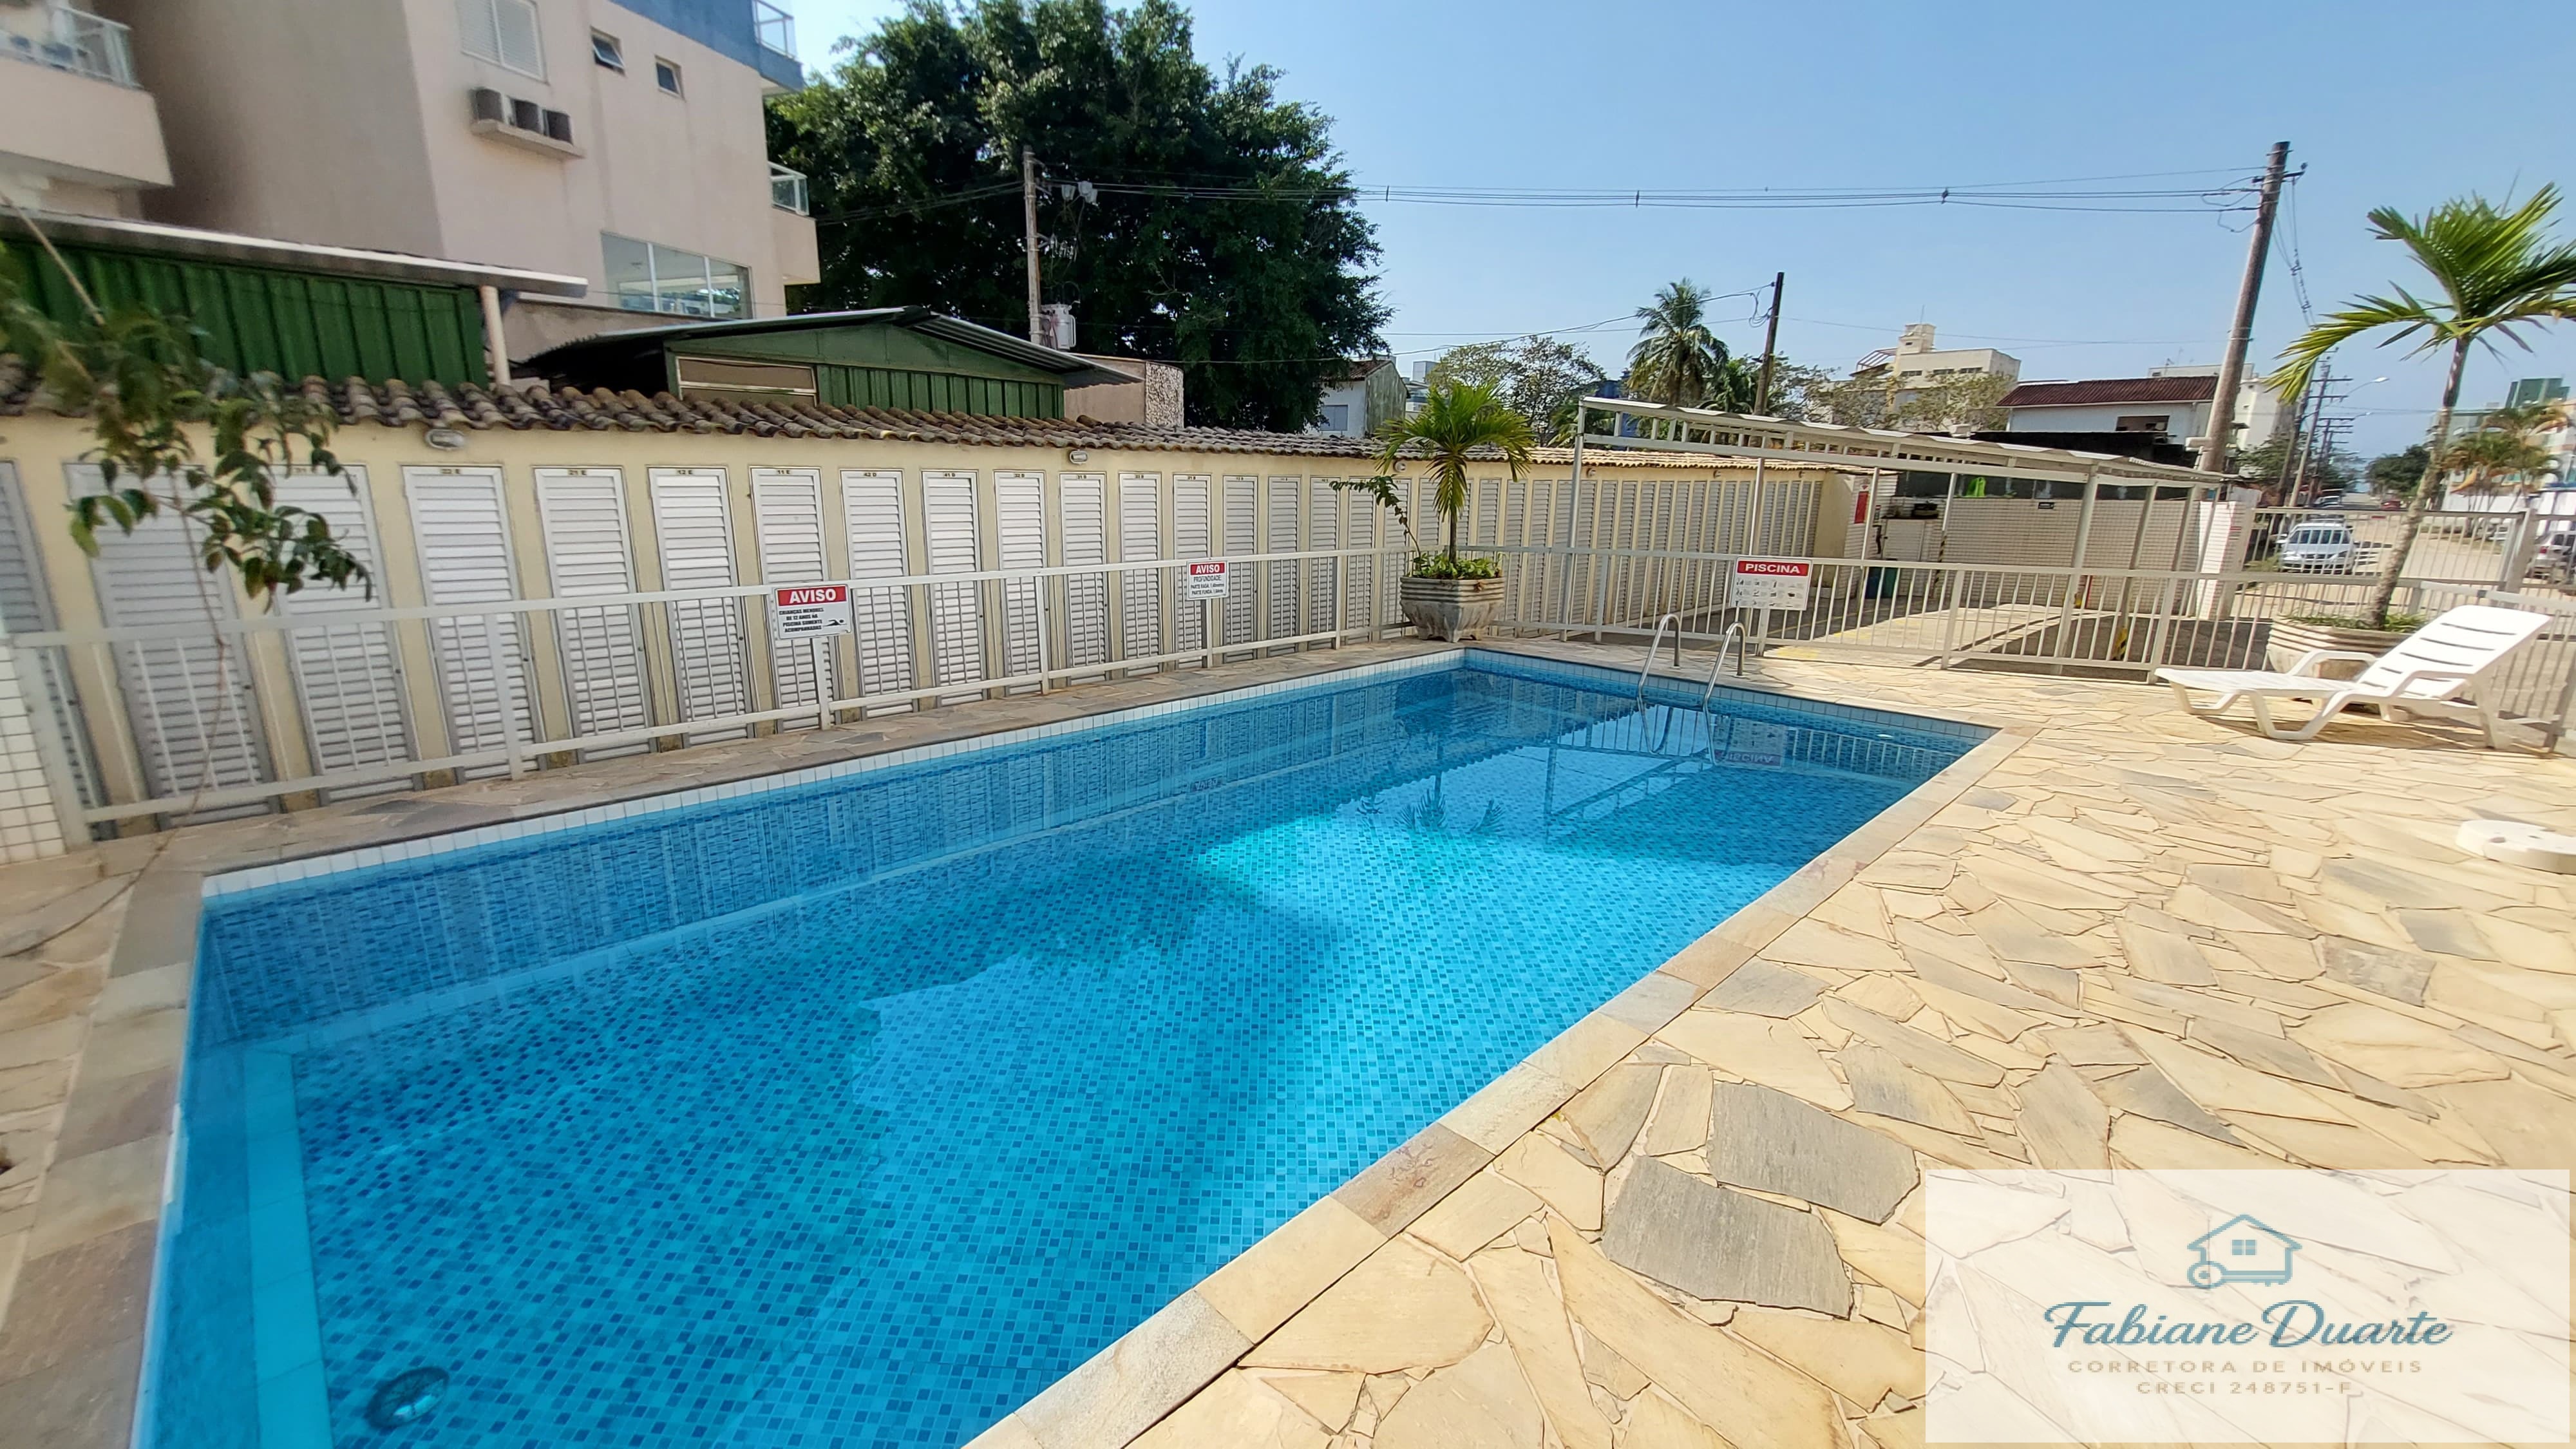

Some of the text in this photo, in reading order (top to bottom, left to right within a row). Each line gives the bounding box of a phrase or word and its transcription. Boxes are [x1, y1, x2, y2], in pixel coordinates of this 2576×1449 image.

[1196, 564, 1220, 574] AVISO
[1745, 564, 1801, 574] PISCINA
[790, 589, 837, 603] AVISO
